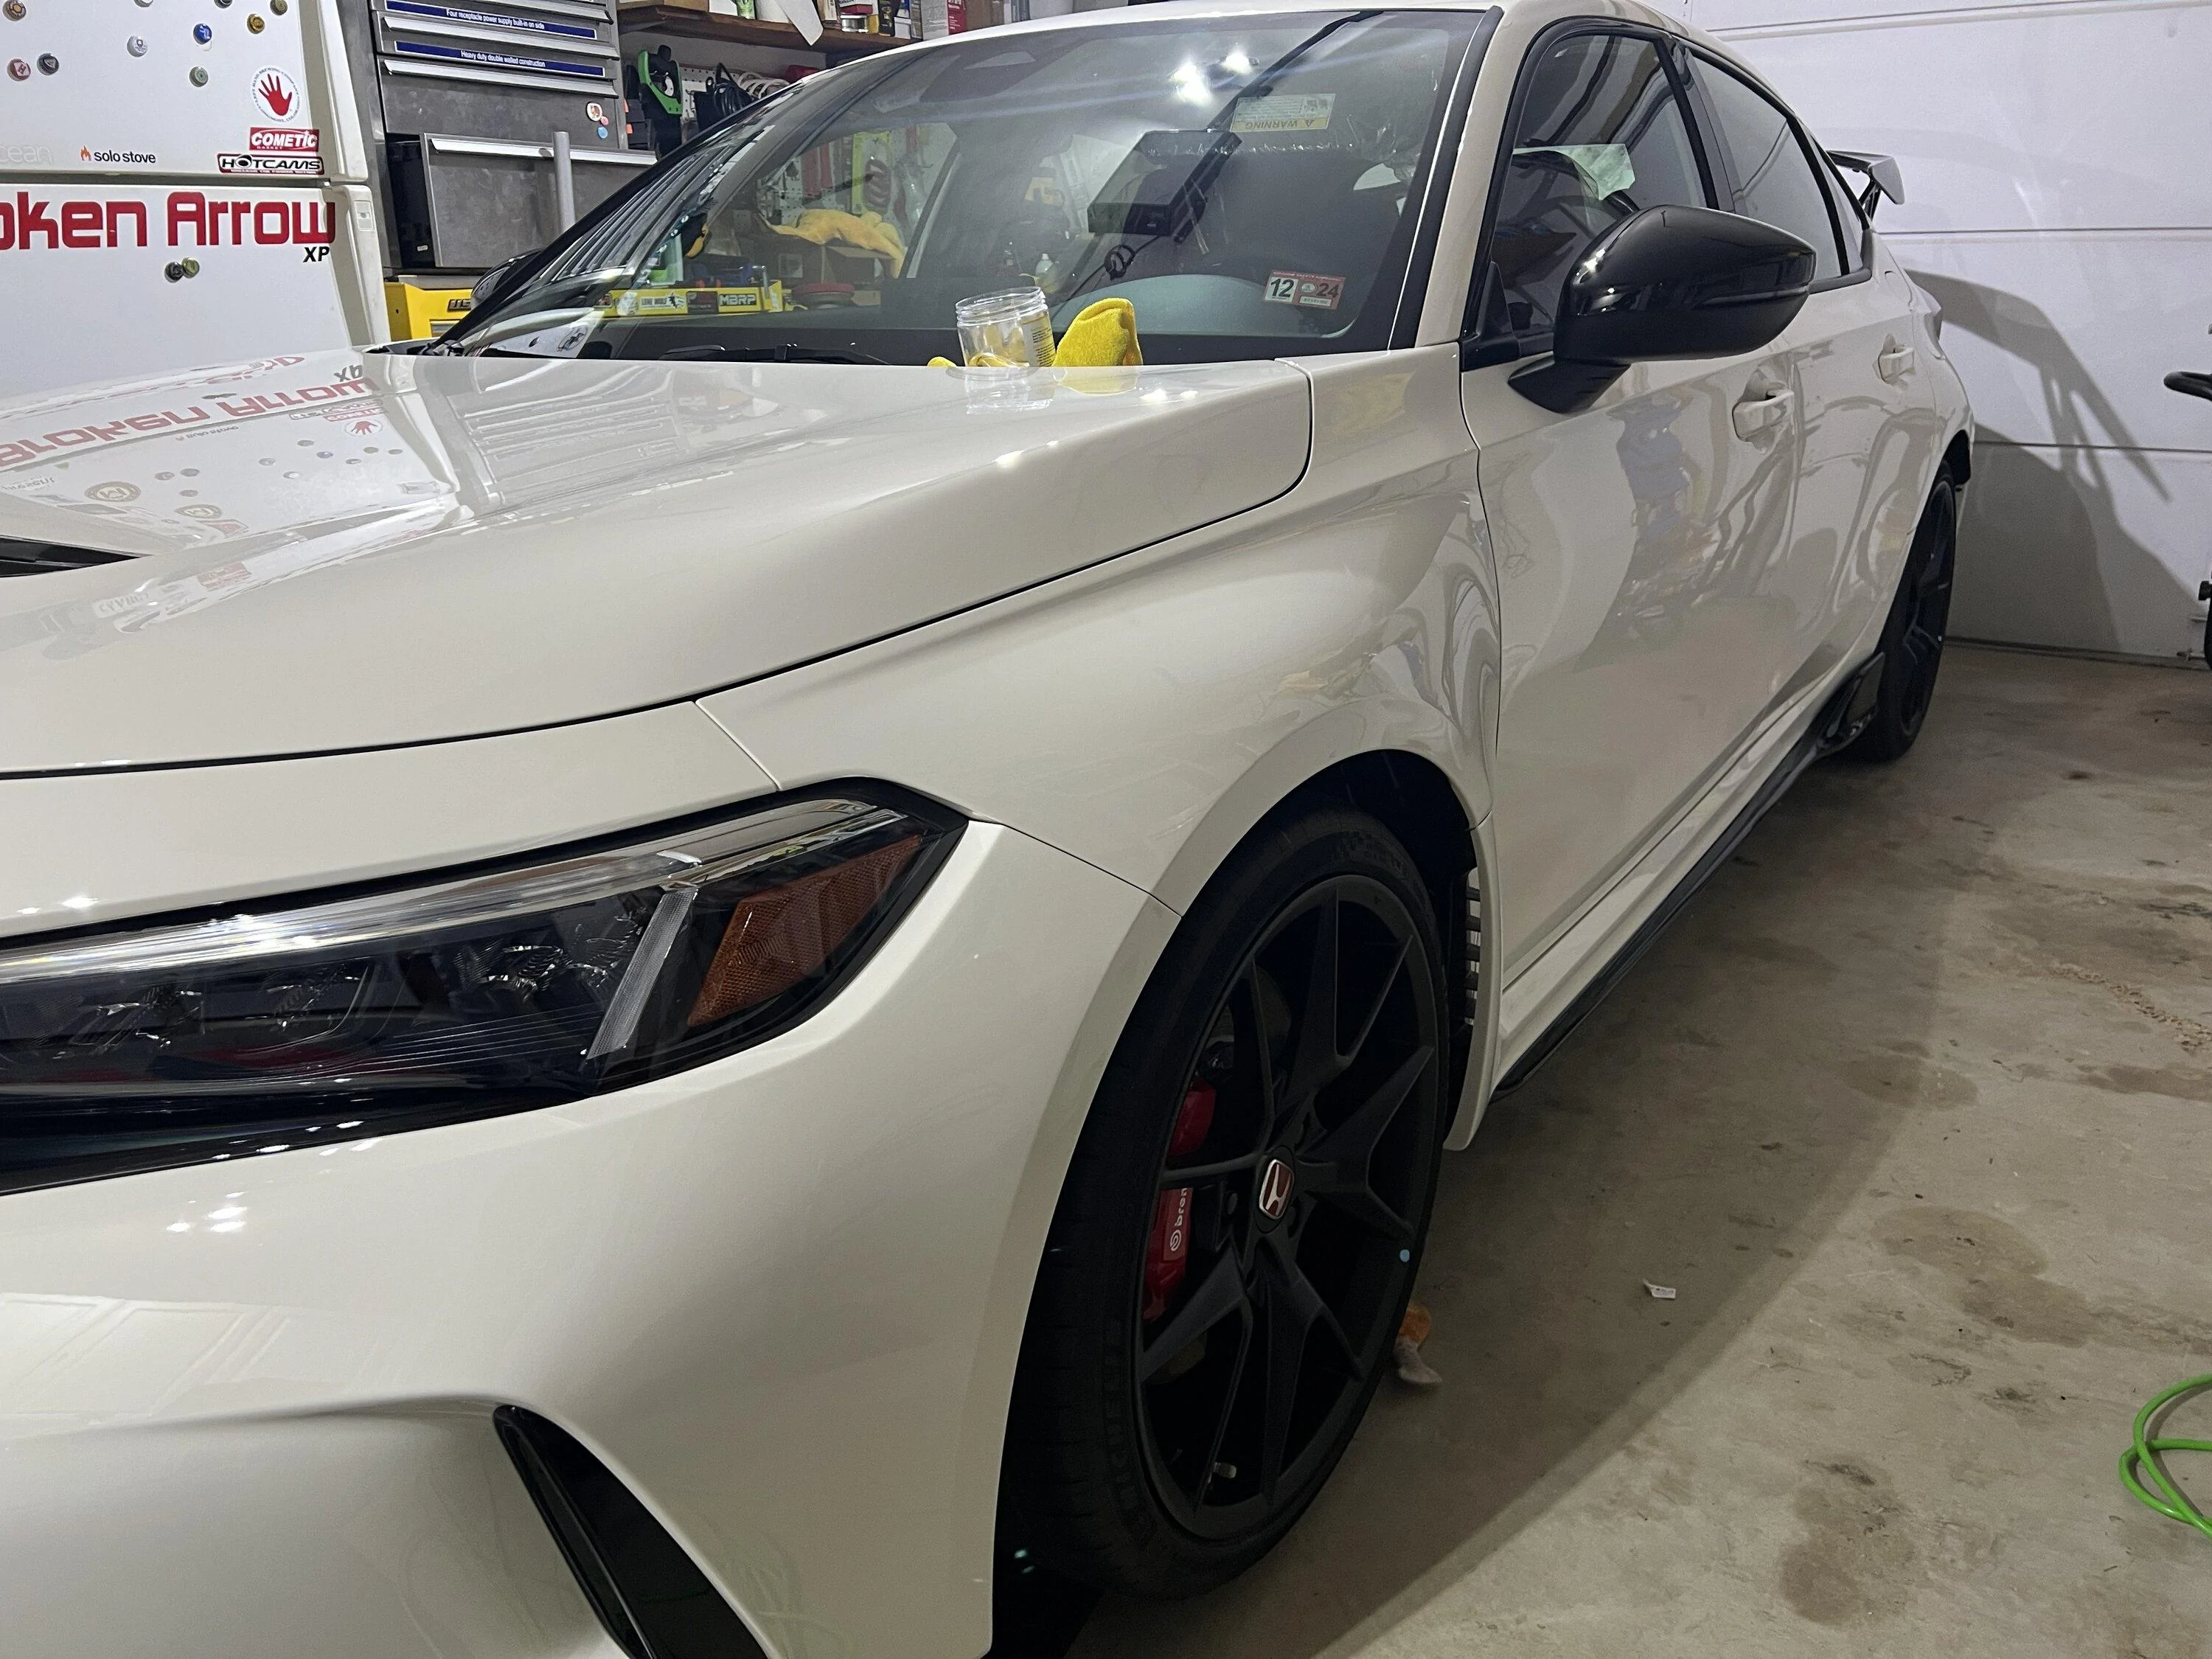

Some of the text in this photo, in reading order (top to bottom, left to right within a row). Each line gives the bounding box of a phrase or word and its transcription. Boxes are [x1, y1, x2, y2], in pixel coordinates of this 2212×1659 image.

[459, 13, 483, 21] receptacle
[498, 18, 513, 27] supply
[513, 19, 528, 27] built-in
[461, 50, 476, 60] Heavy
[477, 52, 487, 61] duty
[487, 55, 503, 63] double
[519, 59, 546, 68] construction
[1245, 119, 1298, 130] WARNING
[251, 131, 318, 147] COMETIC
[94, 150, 156, 163] solo stove
[222, 156, 321, 170] HOTCAMS
[167, 192, 335, 246] Arrow
[303, 246, 330, 263] XP
[1270, 278, 1295, 298] 12
[1316, 282, 1340, 299] 24
[720, 293, 757, 306] MBRP
